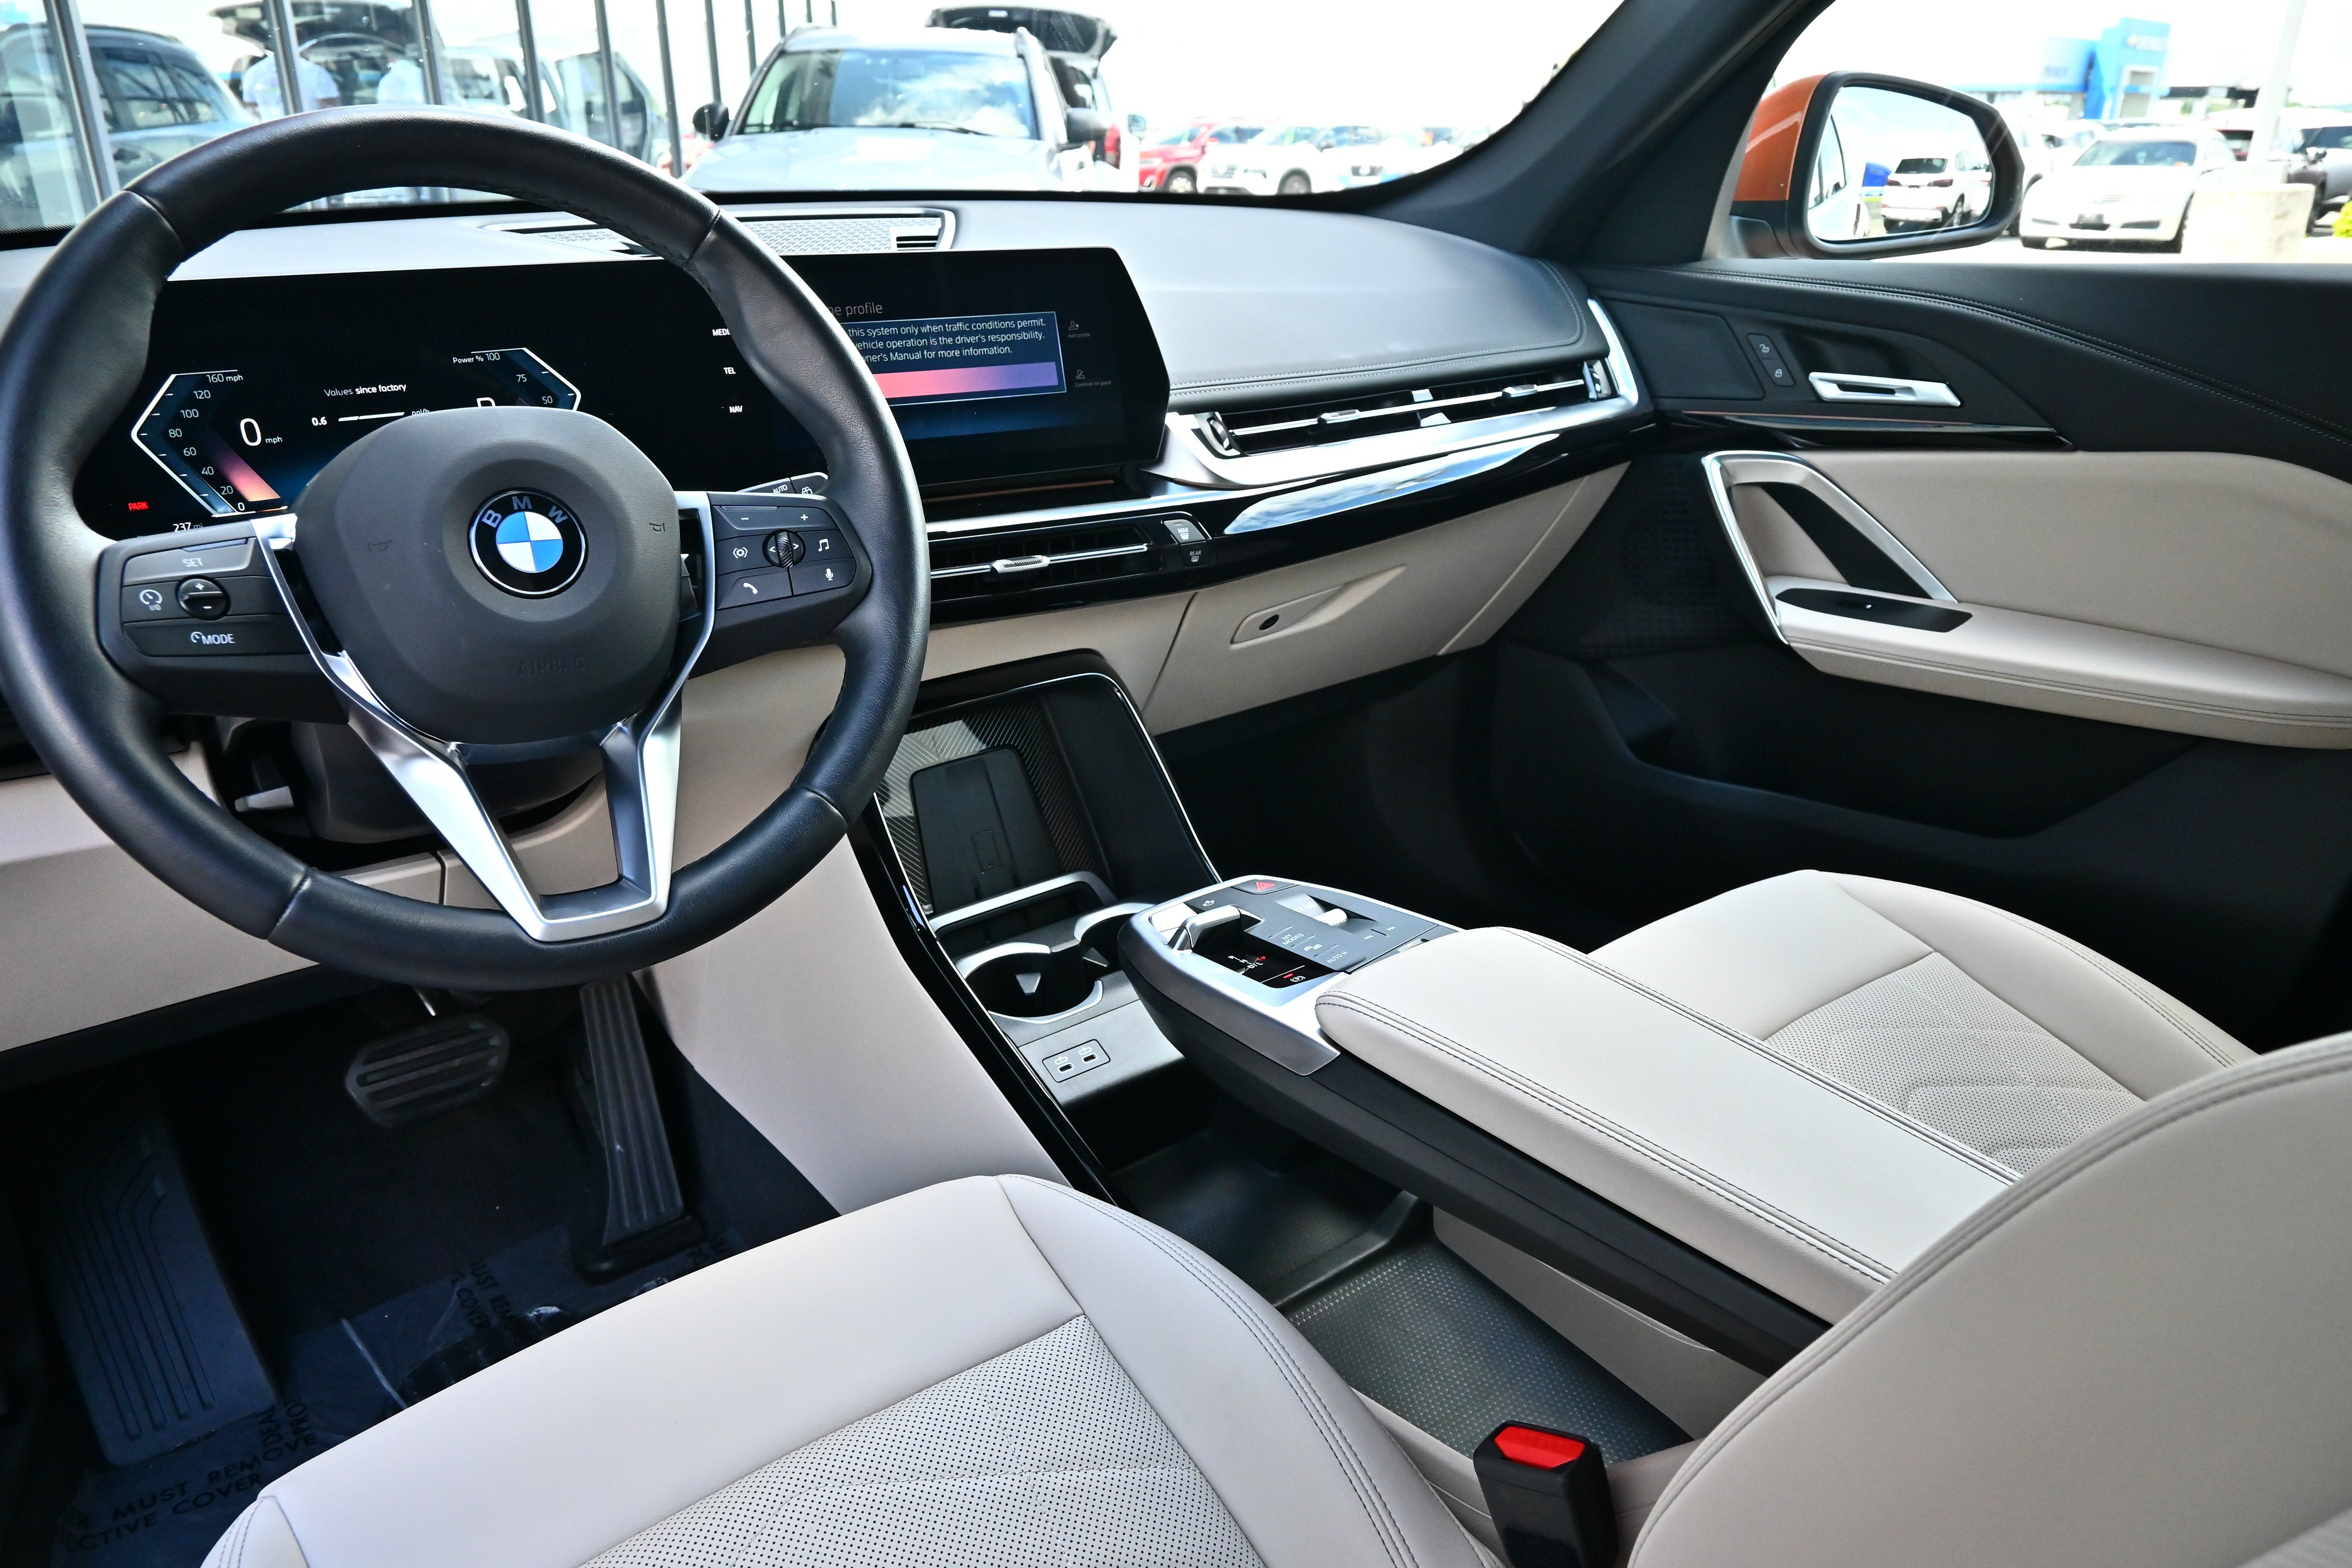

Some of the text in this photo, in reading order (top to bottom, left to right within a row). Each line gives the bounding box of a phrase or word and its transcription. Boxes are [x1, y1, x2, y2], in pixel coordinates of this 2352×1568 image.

[846, 302, 882, 317] profile
[848, 318, 1046, 338] this system only when traffic conditions permit.
[887, 338, 928, 349] operation
[930, 337, 937, 345] is
[939, 337, 953, 345] the
[955, 334, 986, 344] driver's
[988, 331, 1045, 343] responsibility.
[453, 356, 474, 364] Power
[486, 352, 501, 361] 100
[890, 350, 922, 361] Manual
[924, 349, 936, 359] for
[938, 349, 960, 358] more
[962, 346, 1013, 356] information.
[206, 373, 224, 383] 160
[516, 374, 527, 383] 75
[193, 390, 211, 399] 120
[324, 383, 406, 397] Values since factory
[542, 395, 553, 405] 50
[180, 408, 199, 419] 100
[729, 405, 743, 413] NAV
[312, 416, 327, 426] 0.6
[169, 428, 182, 438] 80
[240, 418, 283, 446] 0 mph
[183, 447, 196, 456] 60
[201, 466, 214, 475] 40
[220, 485, 234, 495] 20
[773, 484, 788, 493] AUTO
[128, 501, 149, 511] PARK
[237, 502, 245, 511] 0
[482, 495, 568, 528] BMW
[173, 522, 191, 532] 237
[182, 558, 203, 568] SET
[201, 634, 235, 645] MODE
[1282, 933, 1304, 945] MODES
[1326, 953, 1342, 964] AUTO
[456, 1288, 491, 1331] COVER
[113, 1481, 188, 1522] MUST
[209, 1432, 317, 1484] REMOVE
[172, 1472, 261, 1515] COVER
